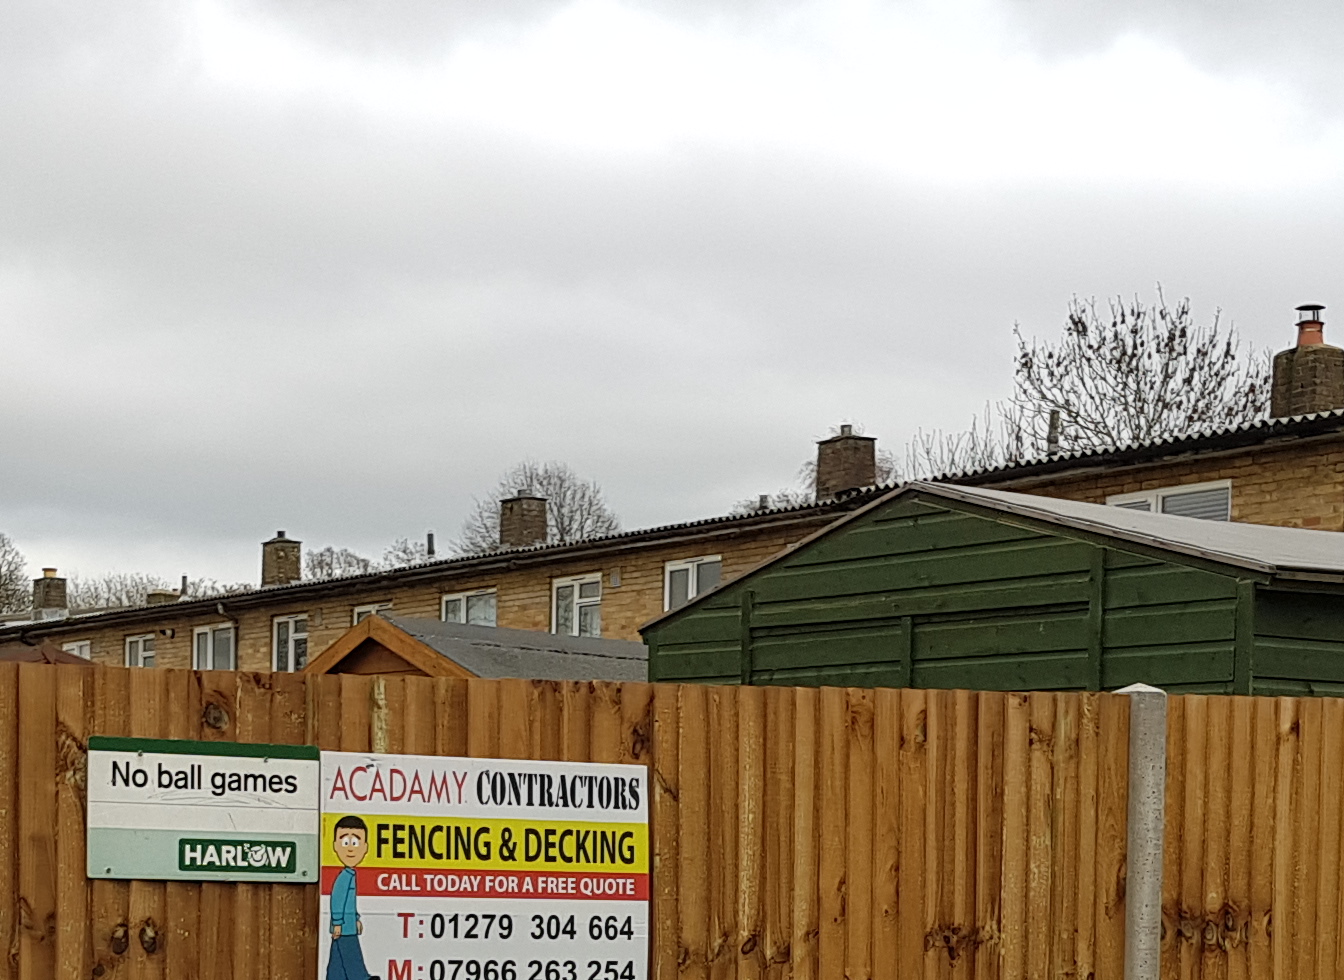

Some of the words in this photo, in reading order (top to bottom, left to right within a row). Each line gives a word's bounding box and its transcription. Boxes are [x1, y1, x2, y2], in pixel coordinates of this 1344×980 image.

[112, 761, 148, 788] No
[158, 763, 202, 790] ball
[211, 772, 298, 797] games
[329, 766, 468, 804] ACADAMY
[476, 770, 640, 810] CONTRACTORS
[184, 844, 291, 868] HARLOW
[376, 823, 491, 861] FENCING
[499, 827, 517, 862] &
[524, 827, 635, 864] DECKING
[377, 873, 420, 891] CALL
[424, 874, 481, 893] TODAY
[485, 876, 518, 893] FOR
[522, 877, 534, 893] A
[538, 877, 575, 894] FREE
[580, 877, 635, 896] QUOTE
[530, 915, 577, 939] 304
[588, 916, 634, 940] 664
